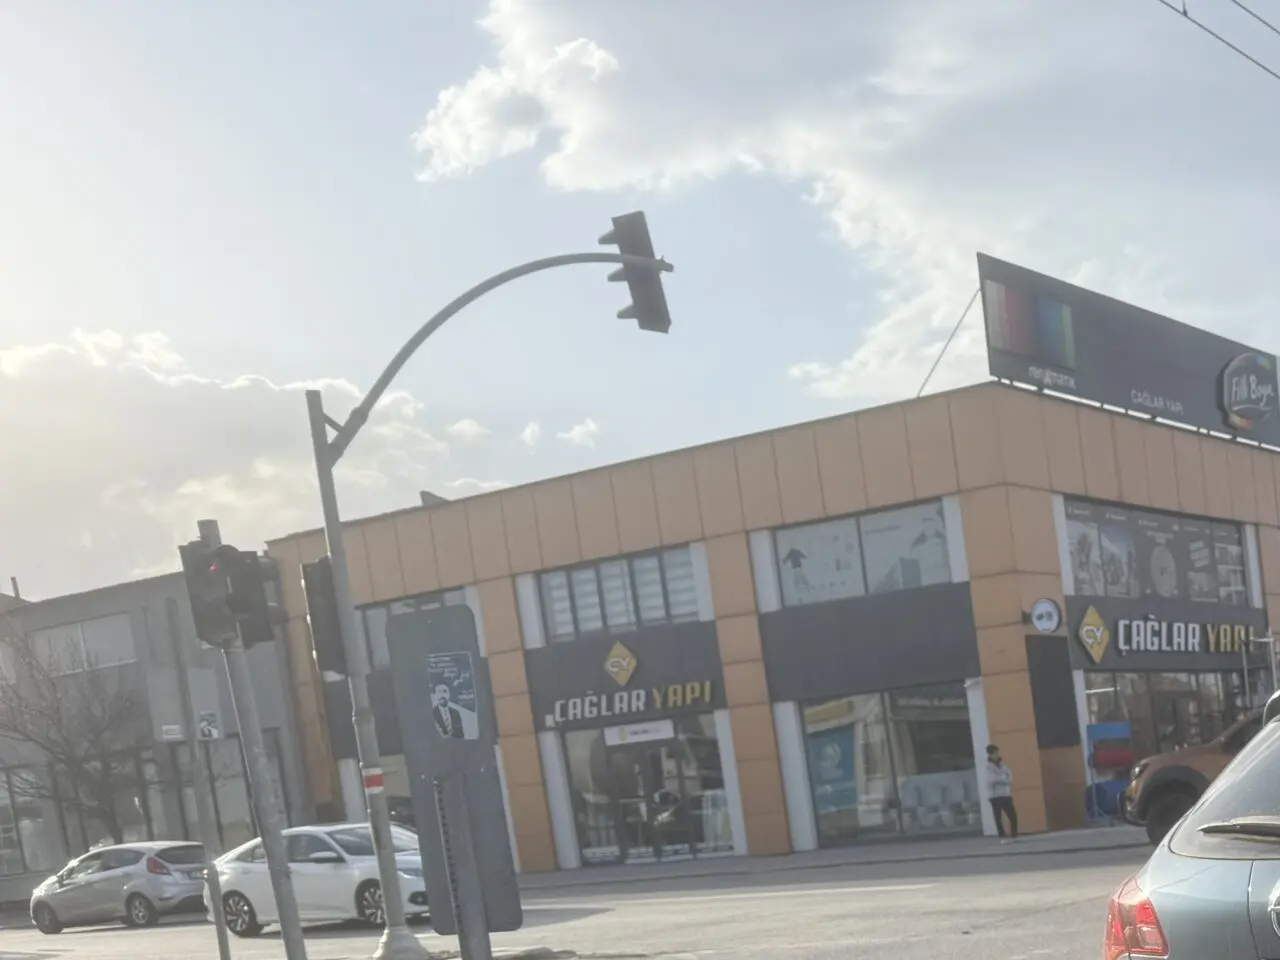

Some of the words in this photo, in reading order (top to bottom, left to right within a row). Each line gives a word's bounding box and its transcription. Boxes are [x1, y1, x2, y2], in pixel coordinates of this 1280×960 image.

[1117, 613, 1201, 656] ÇAĞLAR
[1206, 622, 1255, 654] YAPI
[554, 688, 647, 725] ÇAĞLAR
[652, 680, 712, 709] YAPI
